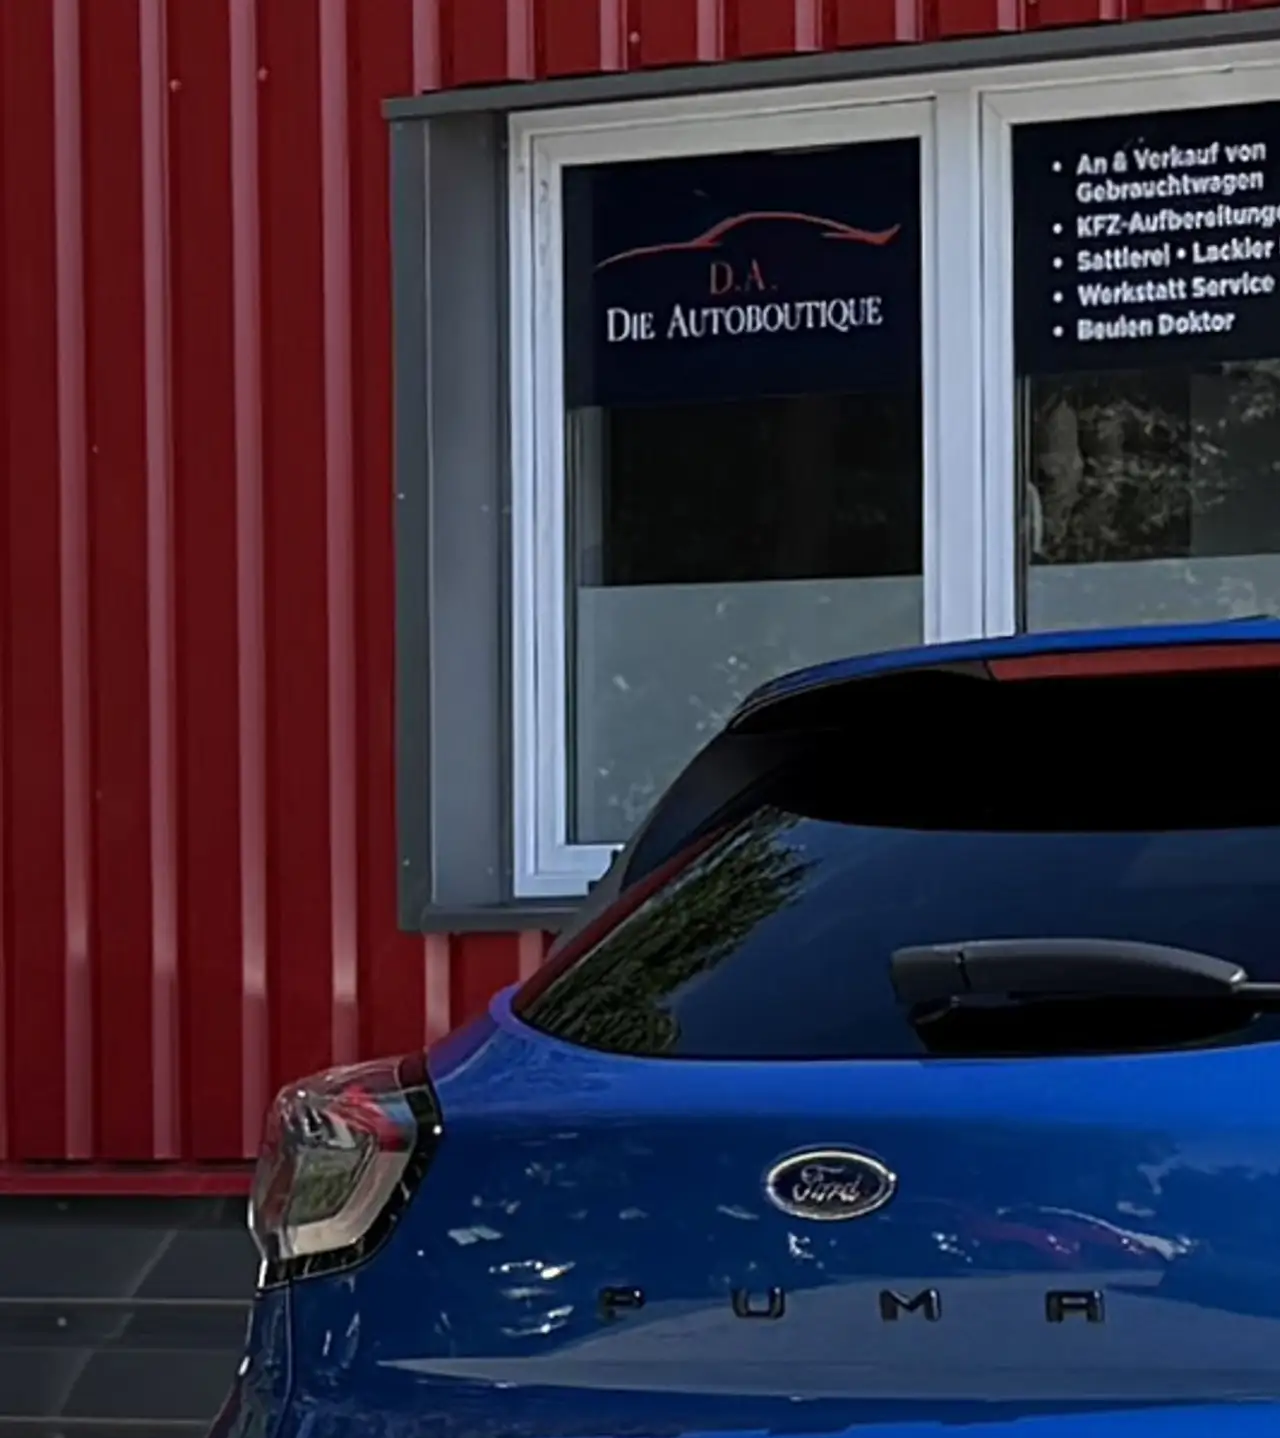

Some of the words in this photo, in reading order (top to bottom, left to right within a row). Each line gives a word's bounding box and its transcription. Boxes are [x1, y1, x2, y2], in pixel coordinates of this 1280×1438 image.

[1077, 153, 1108, 175] An
[1133, 141, 1219, 170] Verkauf
[1225, 142, 1266, 163] von
[1076, 171, 1264, 203] Gebrauchtwagen
[1077, 242, 1171, 272] Sattlerei
[1193, 237, 1274, 264] Lackier
[709, 258, 778, 295] D.A.
[1077, 278, 1187, 306] Werkstatt
[1192, 271, 1275, 298] Service
[666, 297, 883, 338] AUTOBOUTIQUE
[1077, 314, 1153, 341] Beulen
[1158, 310, 1235, 335] Doktor
[791, 1163, 865, 1203] Ford
[598, 1285, 1105, 1323] PUMA
